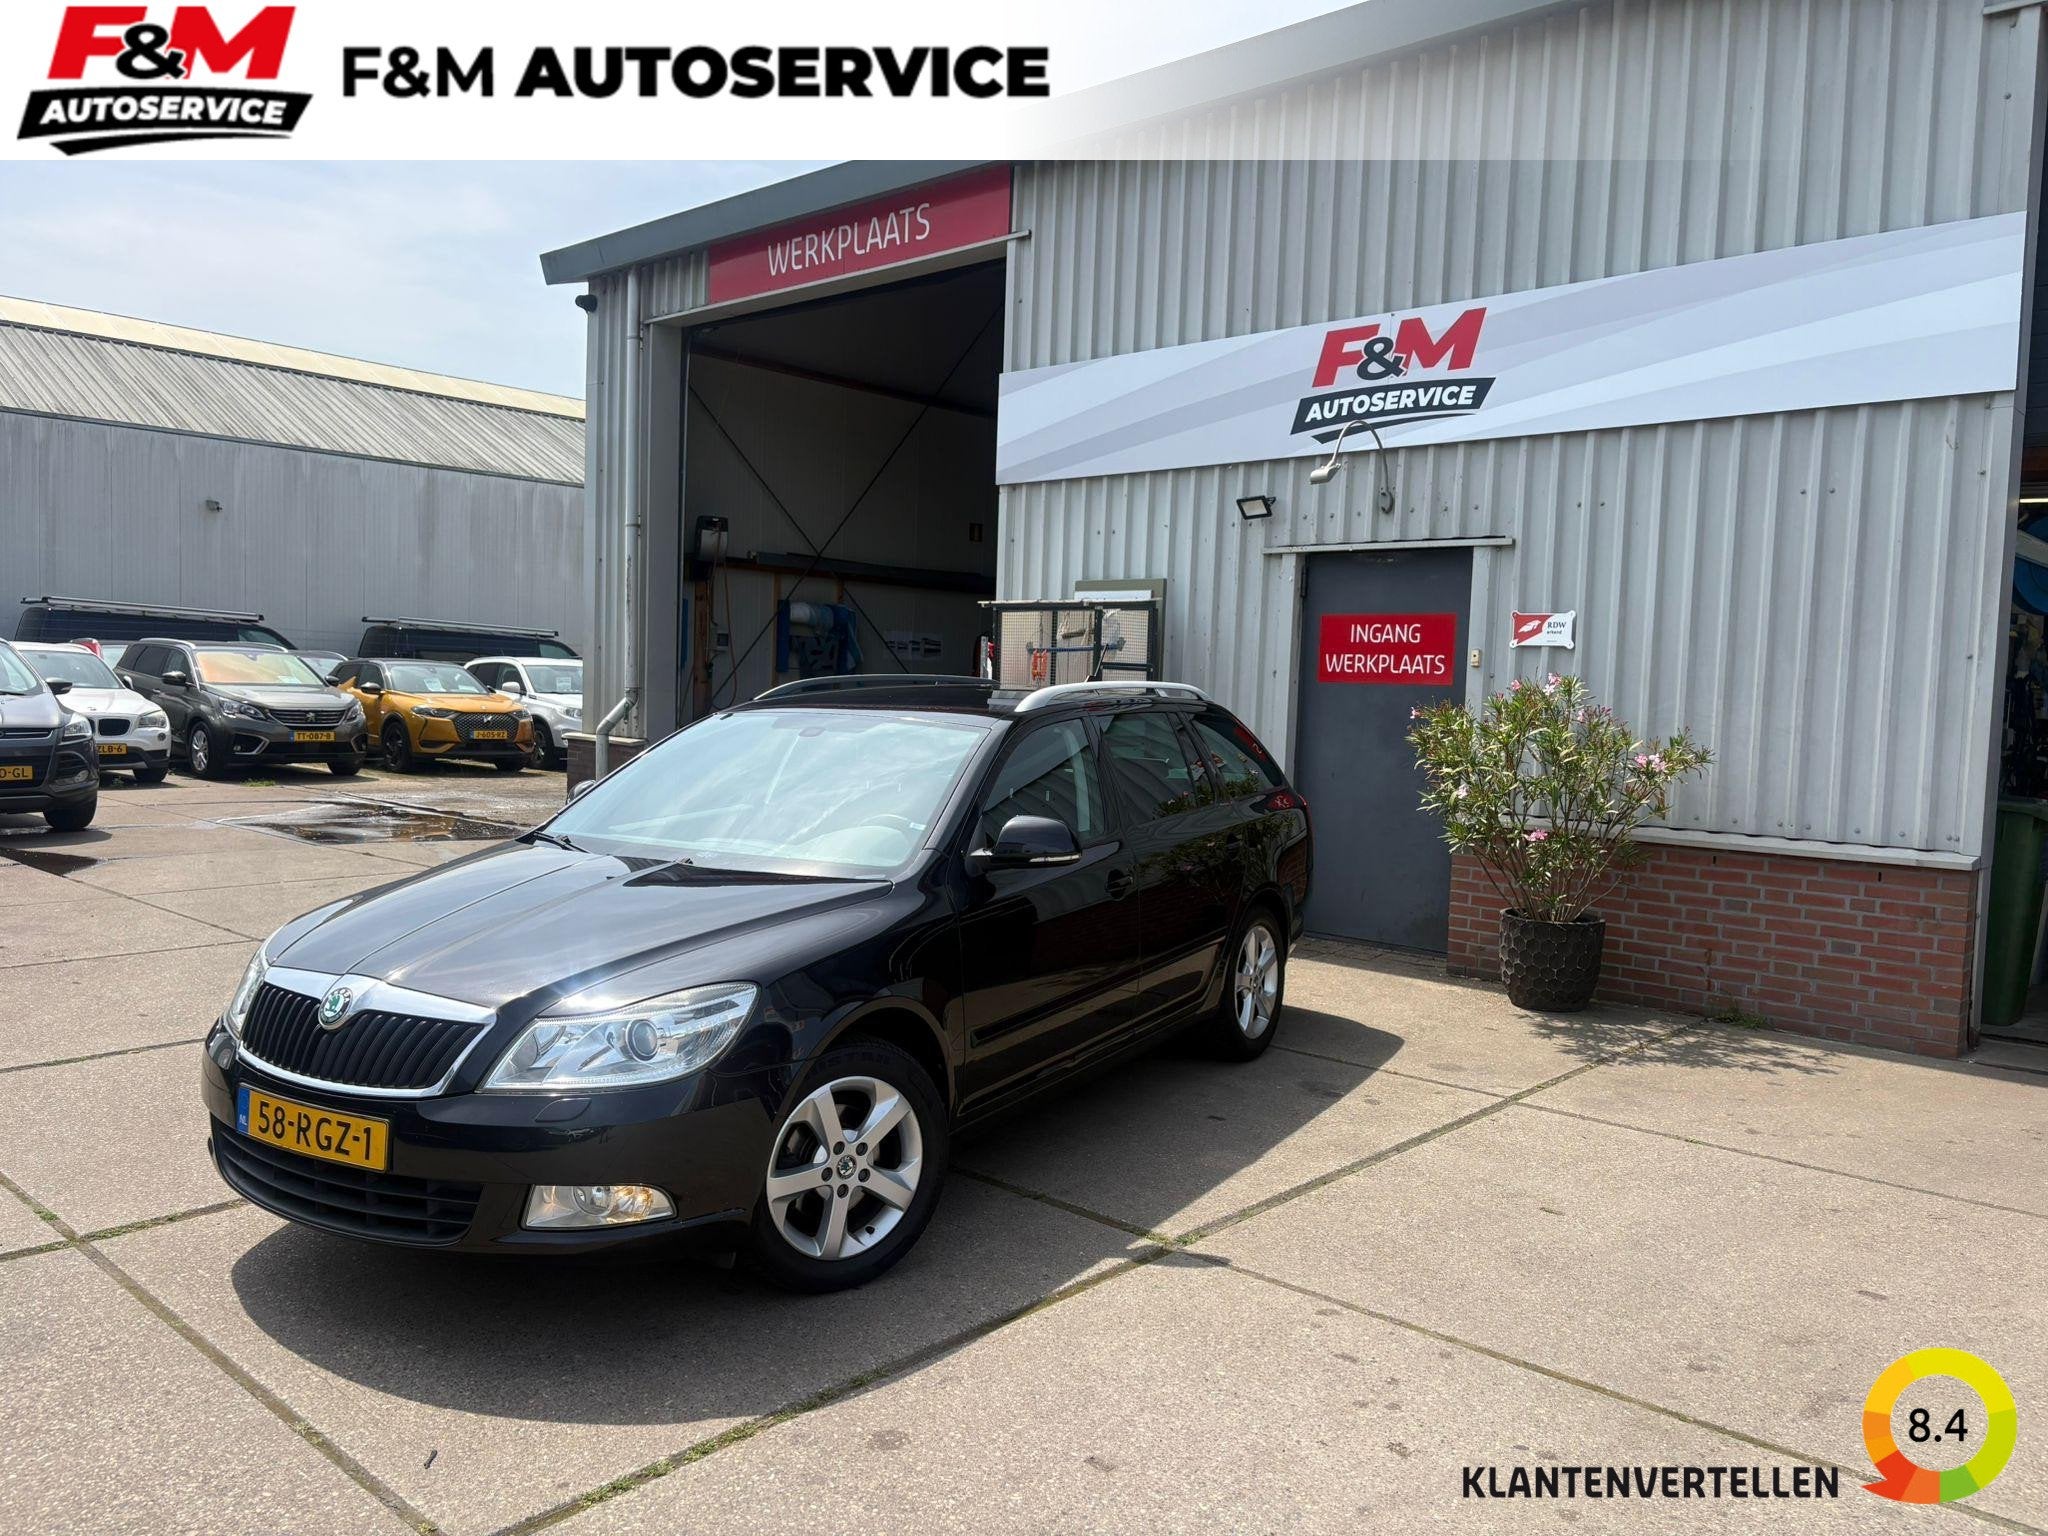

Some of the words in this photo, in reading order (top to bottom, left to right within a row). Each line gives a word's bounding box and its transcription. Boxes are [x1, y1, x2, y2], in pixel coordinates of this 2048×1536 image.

[767, 202, 931, 277] WERKPLAATS
[1312, 307, 1487, 388] F&M
[1304, 385, 1477, 424] AUTOSERVICE
[1350, 623, 1422, 643] INGANG
[1547, 621, 1567, 629] RDW
[1325, 653, 1446, 675] WERKPLAATS
[257, 1100, 372, 1161] 58-RGZ-1
